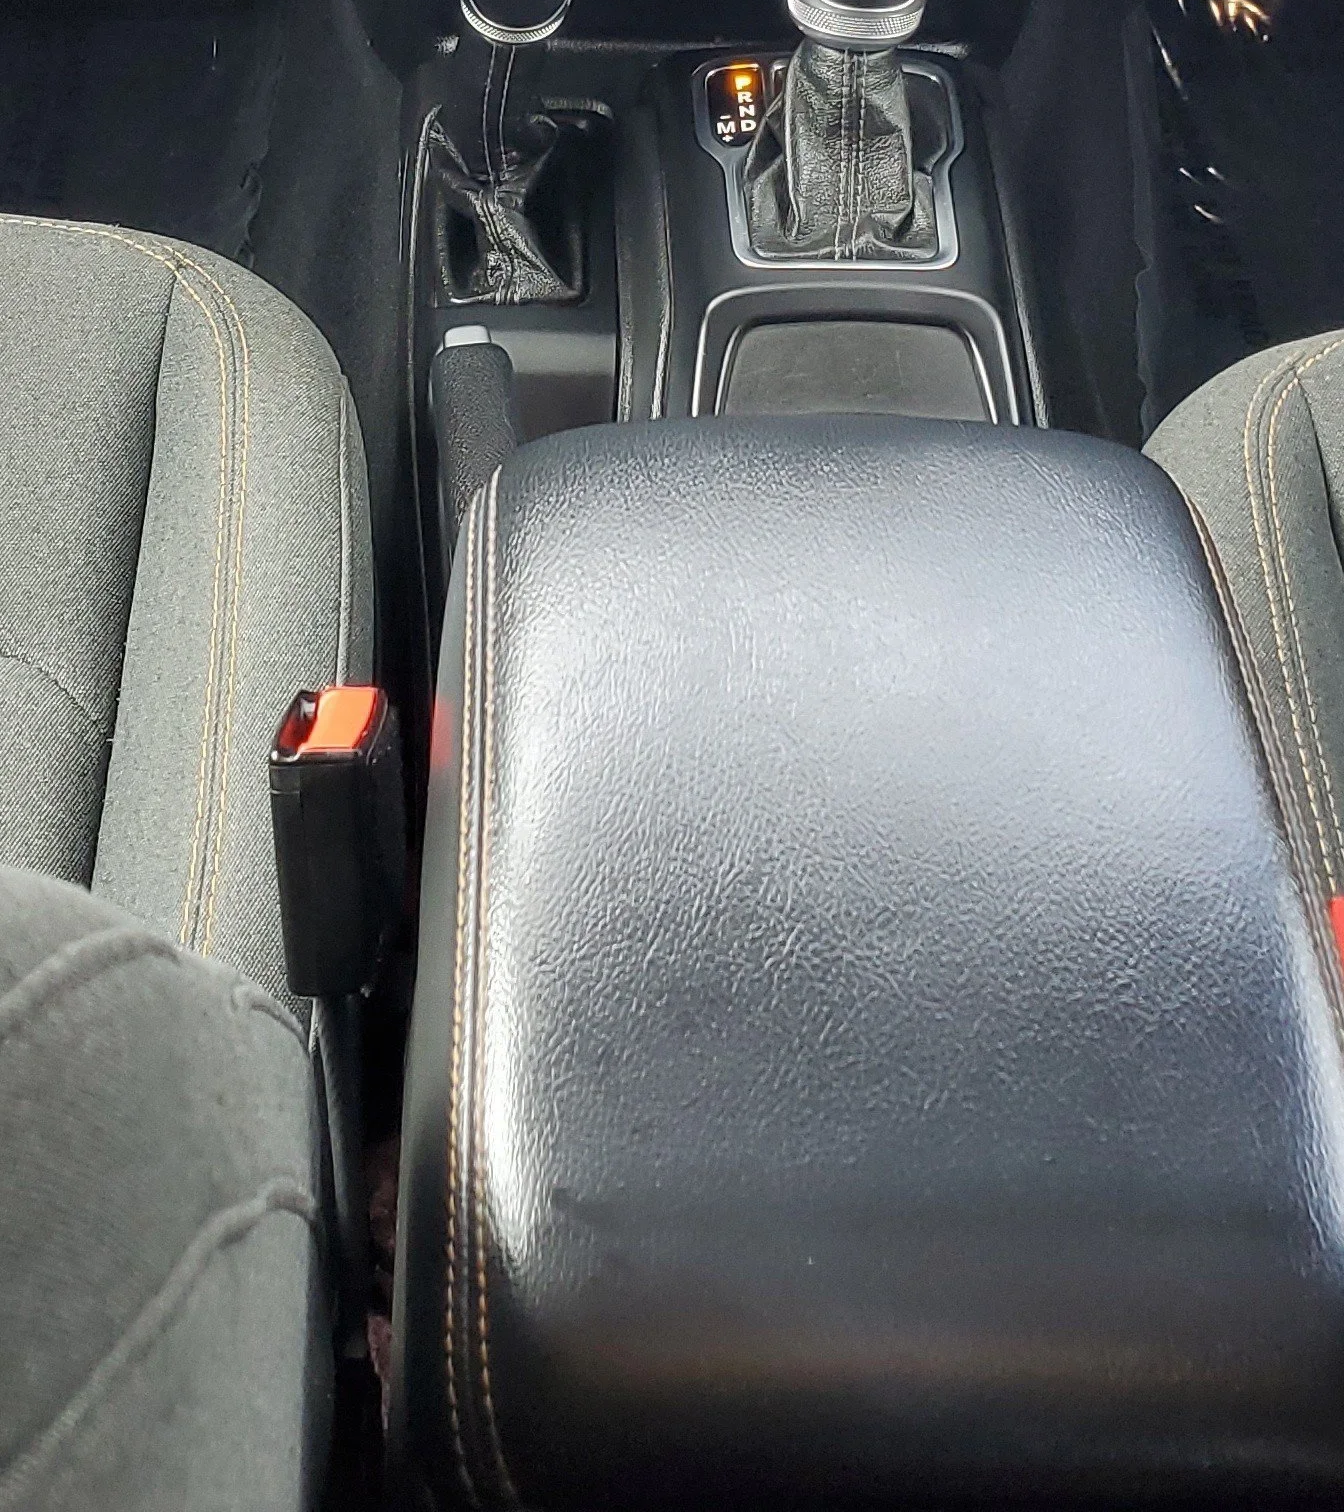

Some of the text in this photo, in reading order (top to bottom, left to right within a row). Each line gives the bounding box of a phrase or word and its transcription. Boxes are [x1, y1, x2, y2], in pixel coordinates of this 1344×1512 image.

[735, 75, 753, 91] P
[737, 91, 754, 104] R
[738, 104, 756, 118] N
[716, 119, 757, 135] M D
